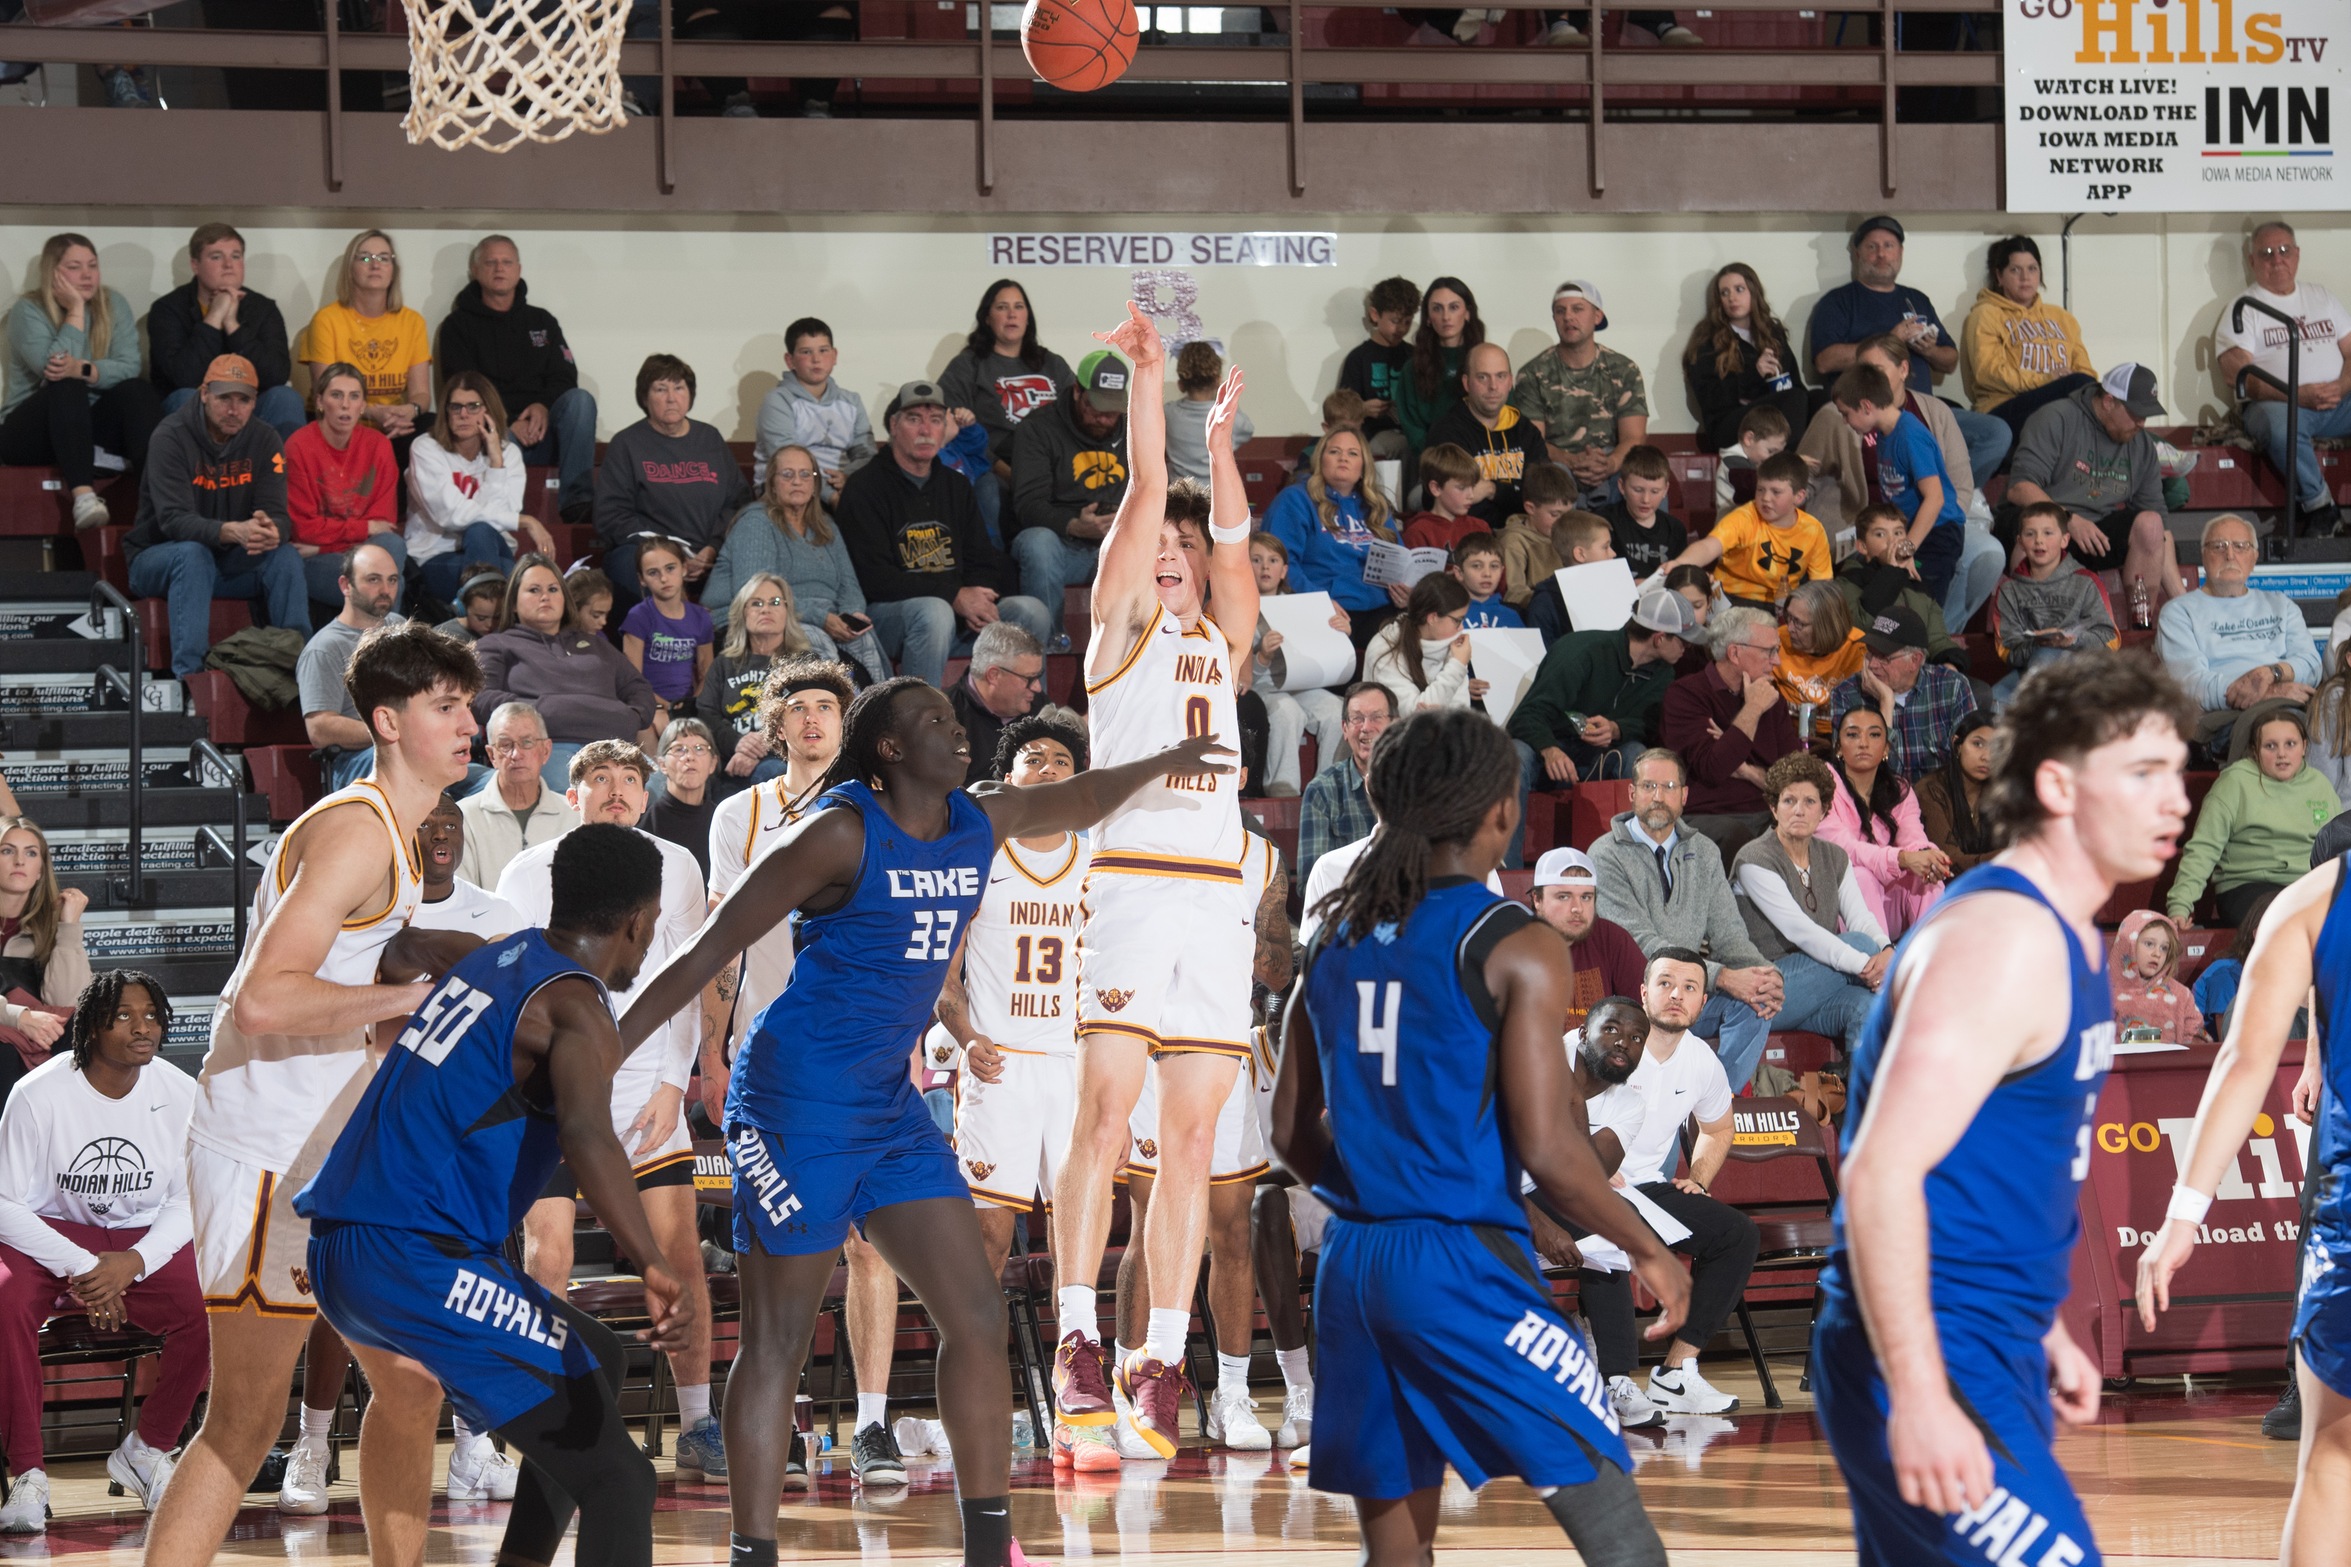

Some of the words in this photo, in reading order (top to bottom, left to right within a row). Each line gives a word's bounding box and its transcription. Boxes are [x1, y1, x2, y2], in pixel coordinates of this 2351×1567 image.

[2020, 0, 2072, 19] GO
[2075, 0, 2285, 64] Hills
[2286, 38, 2328, 62] TV
[2034, 79, 2114, 94] WATCH
[2120, 79, 2177, 94] LIVE!
[2019, 105, 2148, 121] DOWNLOAD
[2153, 105, 2197, 121] THE
[2205, 86, 2330, 145] IMN
[2039, 131, 2098, 147] IOWA
[2103, 131, 2178, 147] MEDIA
[2049, 158, 2164, 173] NETWORK
[2202, 168, 2231, 182] IOWA
[2234, 168, 2273, 182] MEDIA
[2276, 166, 2333, 182] NETWORK
[2086, 184, 2132, 199] APP
[992, 235, 1173, 265] RESERVED
[1190, 235, 1332, 265] SEATING
[33, 615, 56, 623] our
[15, 687, 28, 696] to
[32, 687, 86, 699] fulfilling
[1184, 693, 1213, 738] 0
[3, 764, 69, 776] dedicated
[75, 764, 88, 773] to
[150, 763, 173, 771] our
[6, 773, 57, 784] truction
[59, 844, 127, 855] dedicated
[149, 843, 195, 854] fulfillin
[886, 867, 980, 898] LAKE
[1010, 900, 1075, 928] INDIAN
[84, 930, 122, 940] eople
[126, 925, 193, 937] dedicated
[199, 925, 213, 934] to
[96, 934, 181, 947] construction
[904, 909, 959, 961] 33
[109, 944, 235, 956] www.christnercontracti
[1014, 933, 1065, 986] 13
[1010, 993, 1061, 1018] HILLS
[397, 973, 495, 1069] 50
[1356, 981, 1402, 1086] 4
[1756, 1111, 1800, 1132] HILLS
[1735, 1134, 1789, 1143] RRIORS
[2097, 1121, 2161, 1154] GO
[56, 1172, 108, 1195] INDIAN
[112, 1171, 154, 1194] HILLS
[735, 1125, 803, 1228] ROYALS
[2117, 1222, 2265, 1247] Doload
[2274, 1220, 2300, 1242] th
[444, 1267, 570, 1351] ROYALS
